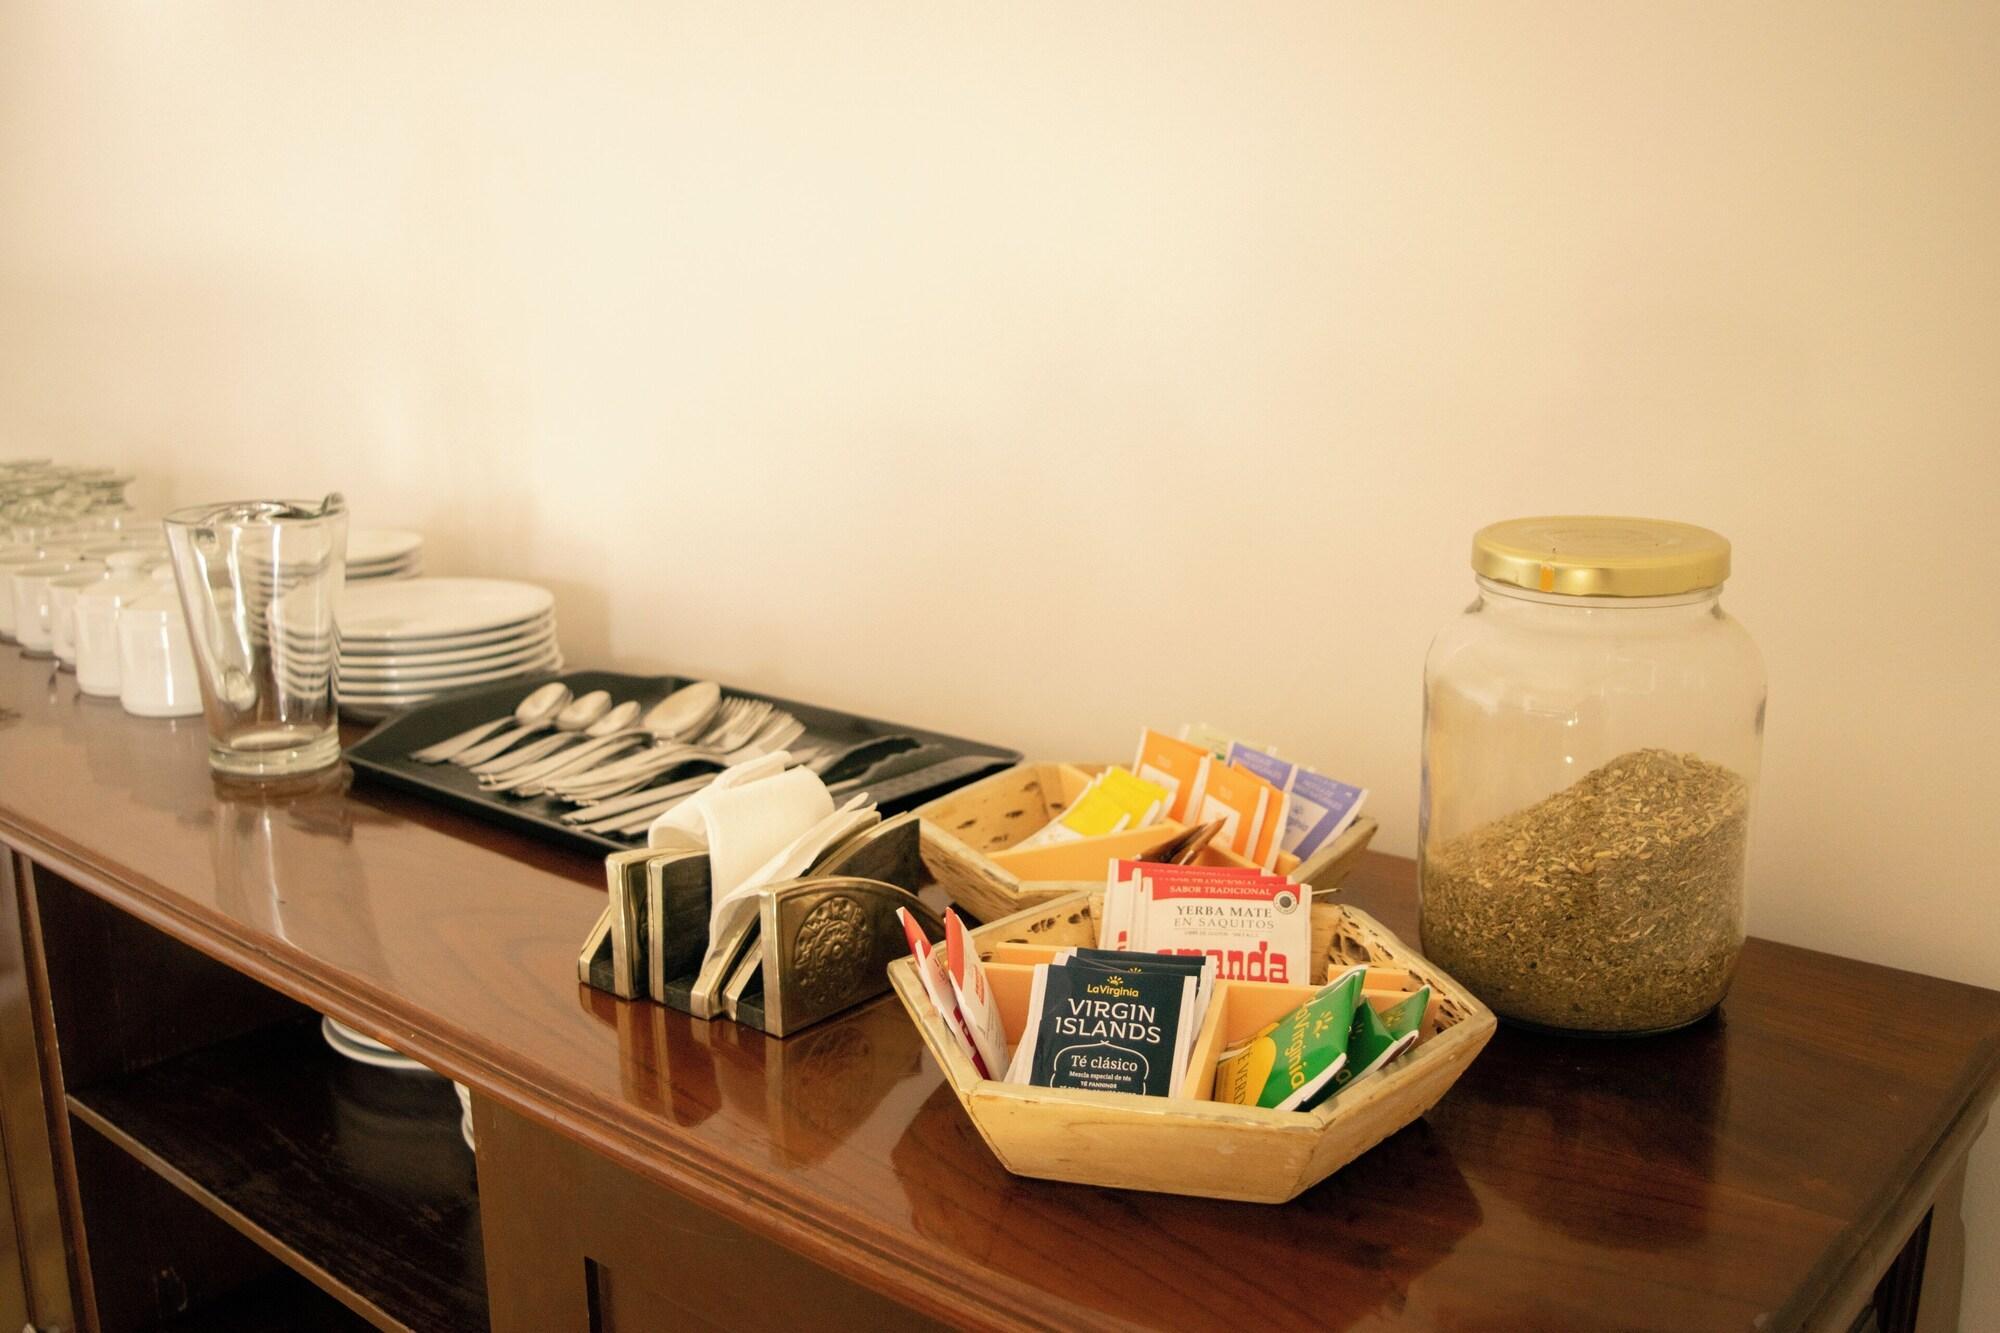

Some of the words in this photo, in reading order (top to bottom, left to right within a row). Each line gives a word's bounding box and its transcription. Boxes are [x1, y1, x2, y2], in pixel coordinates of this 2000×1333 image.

[1169, 885, 1201, 894] SABOR
[1204, 886, 1272, 896] TRADICIONAL
[1176, 905, 1224, 916] YERBA
[1230, 906, 1272, 918] MATE
[1174, 918, 1192, 927] EN
[1199, 918, 1275, 929] SAQUITOS
[1156, 941, 1289, 984] anda
[1068, 998, 1155, 1024] VIRGIN
[1055, 1016, 1162, 1044] ISLANDS
[1284, 1003, 1312, 1089] aVirginia
[1071, 1055, 1087, 1068] Té
[1090, 1056, 1138, 1072] clásico
